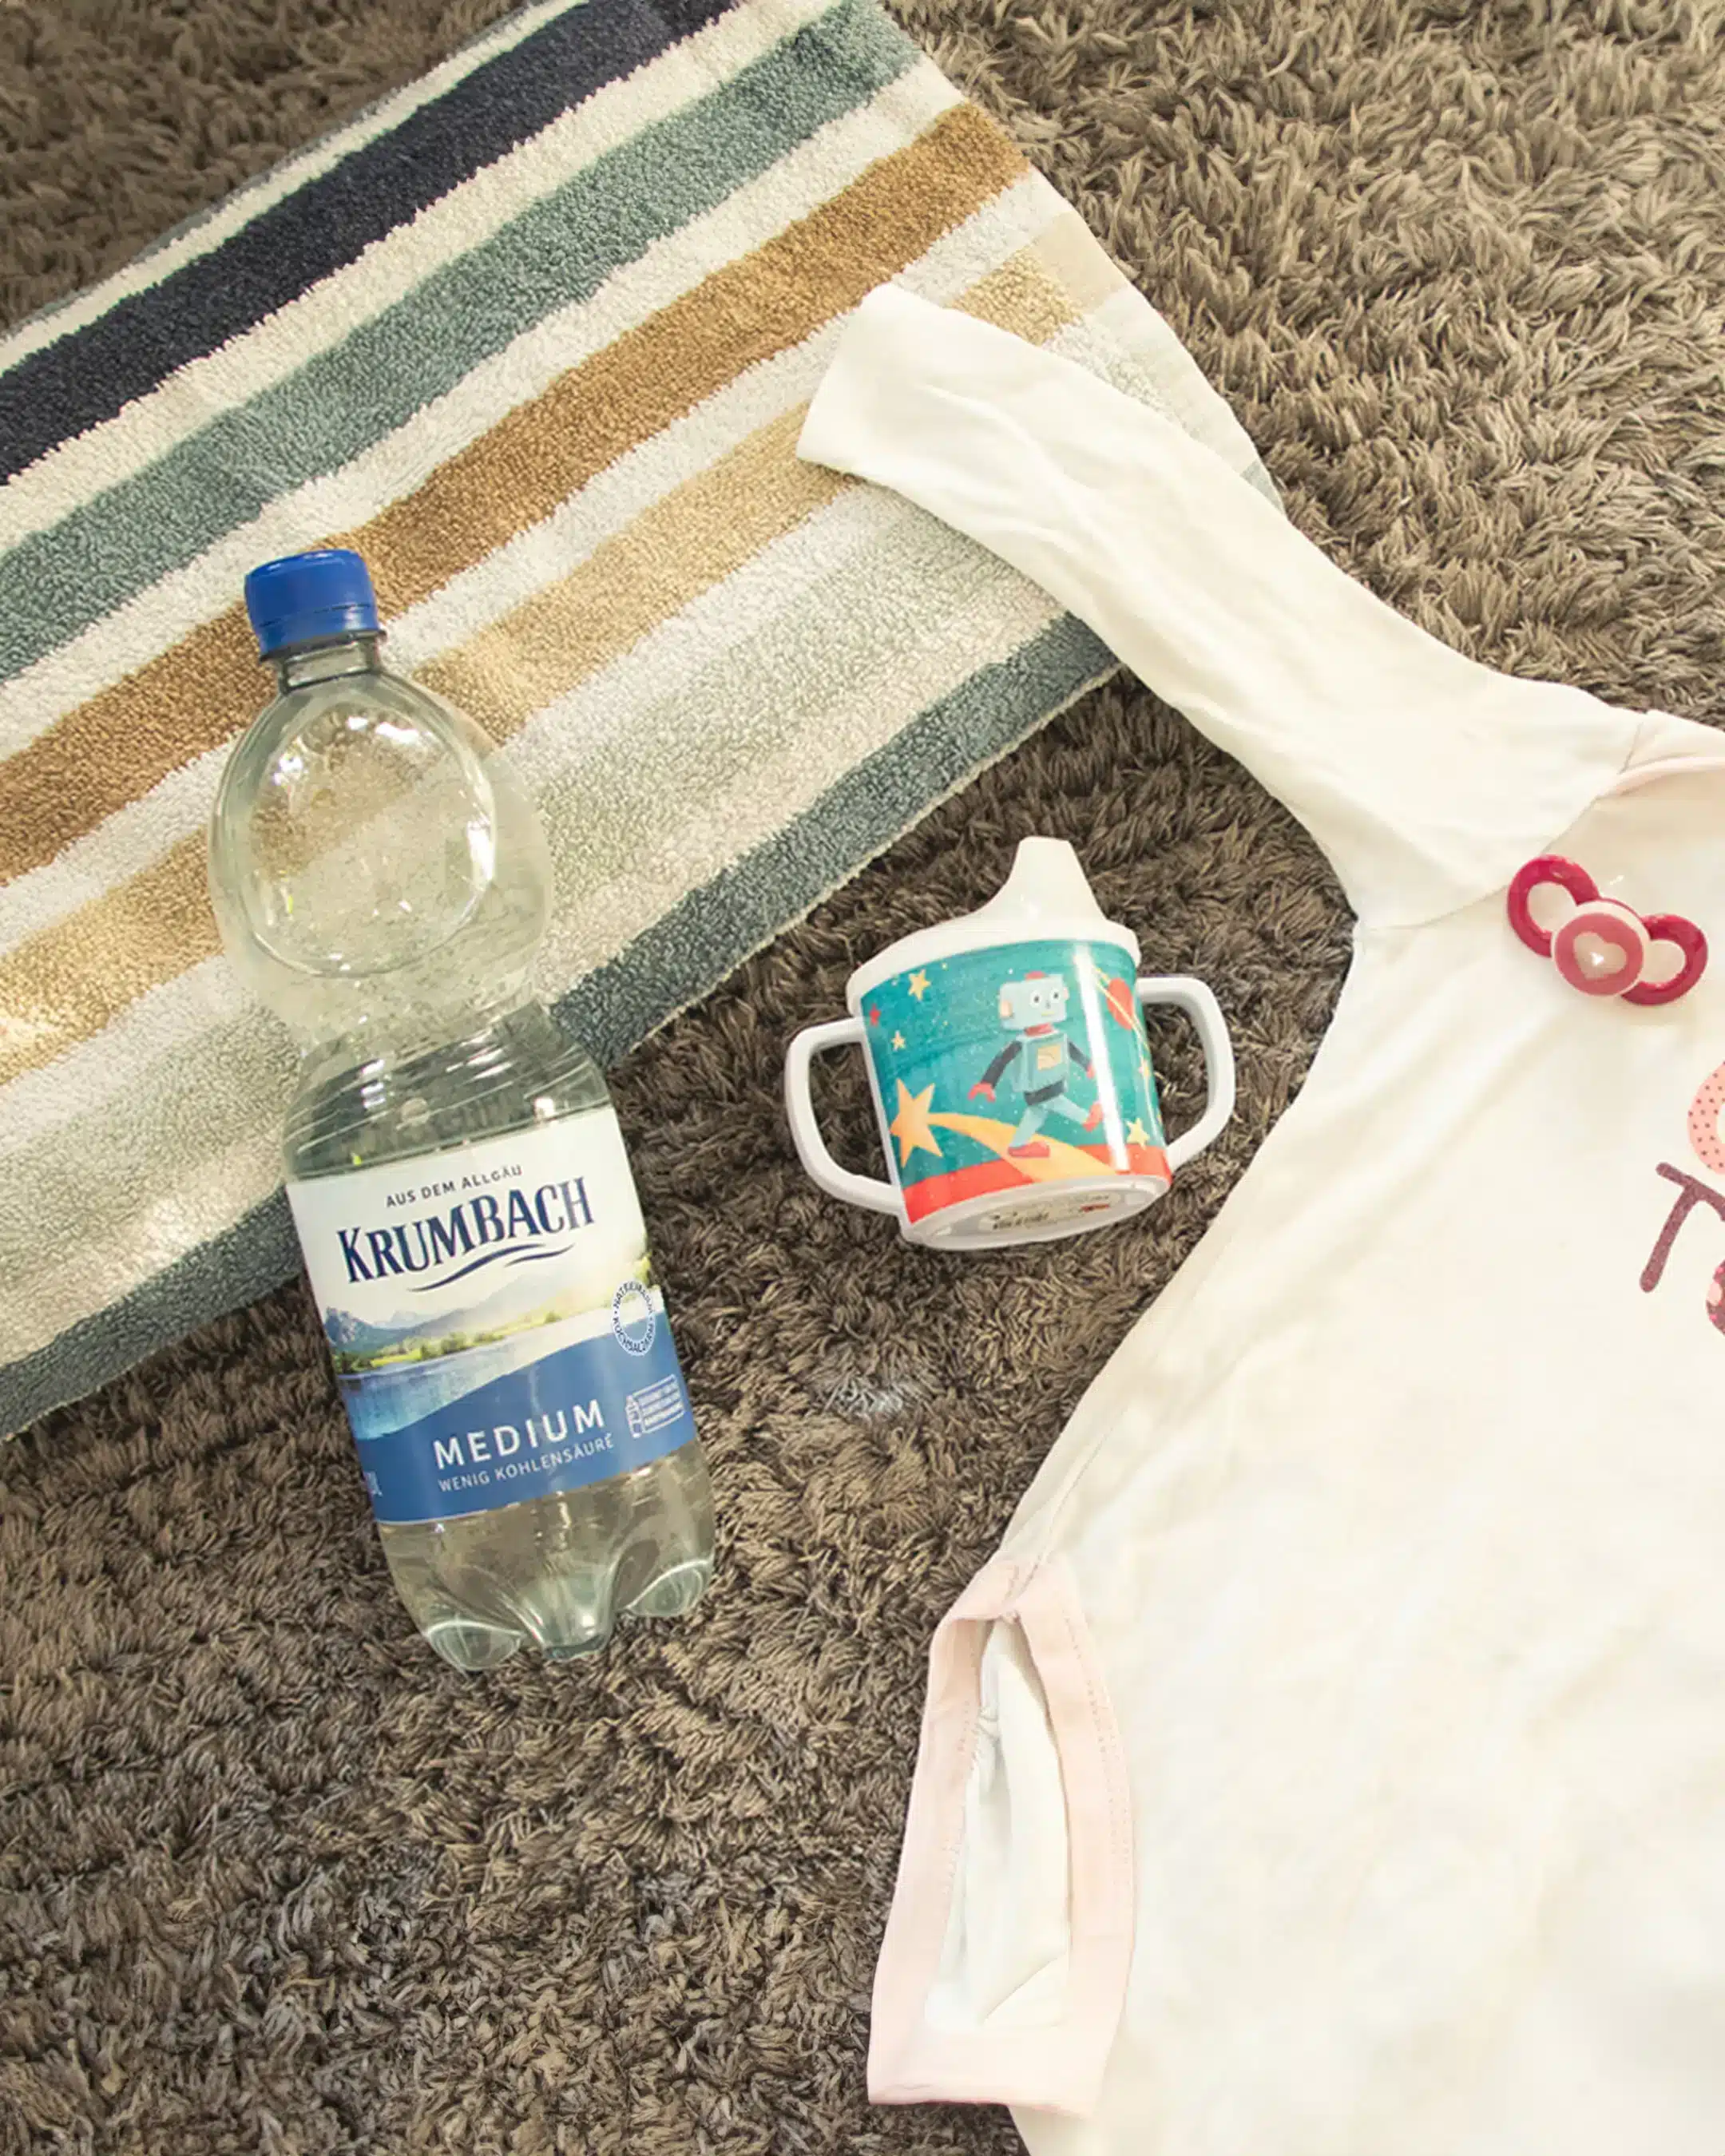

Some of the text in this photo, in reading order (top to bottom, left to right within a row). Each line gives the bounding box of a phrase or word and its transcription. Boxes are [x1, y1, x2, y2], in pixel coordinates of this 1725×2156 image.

[386, 1163, 522, 1208] AUS DEM ALLGÄU
[336, 1175, 595, 1283] KRUMBACH
[432, 1398, 605, 1470] MEDIUM
[438, 1470, 490, 1492] WENIG
